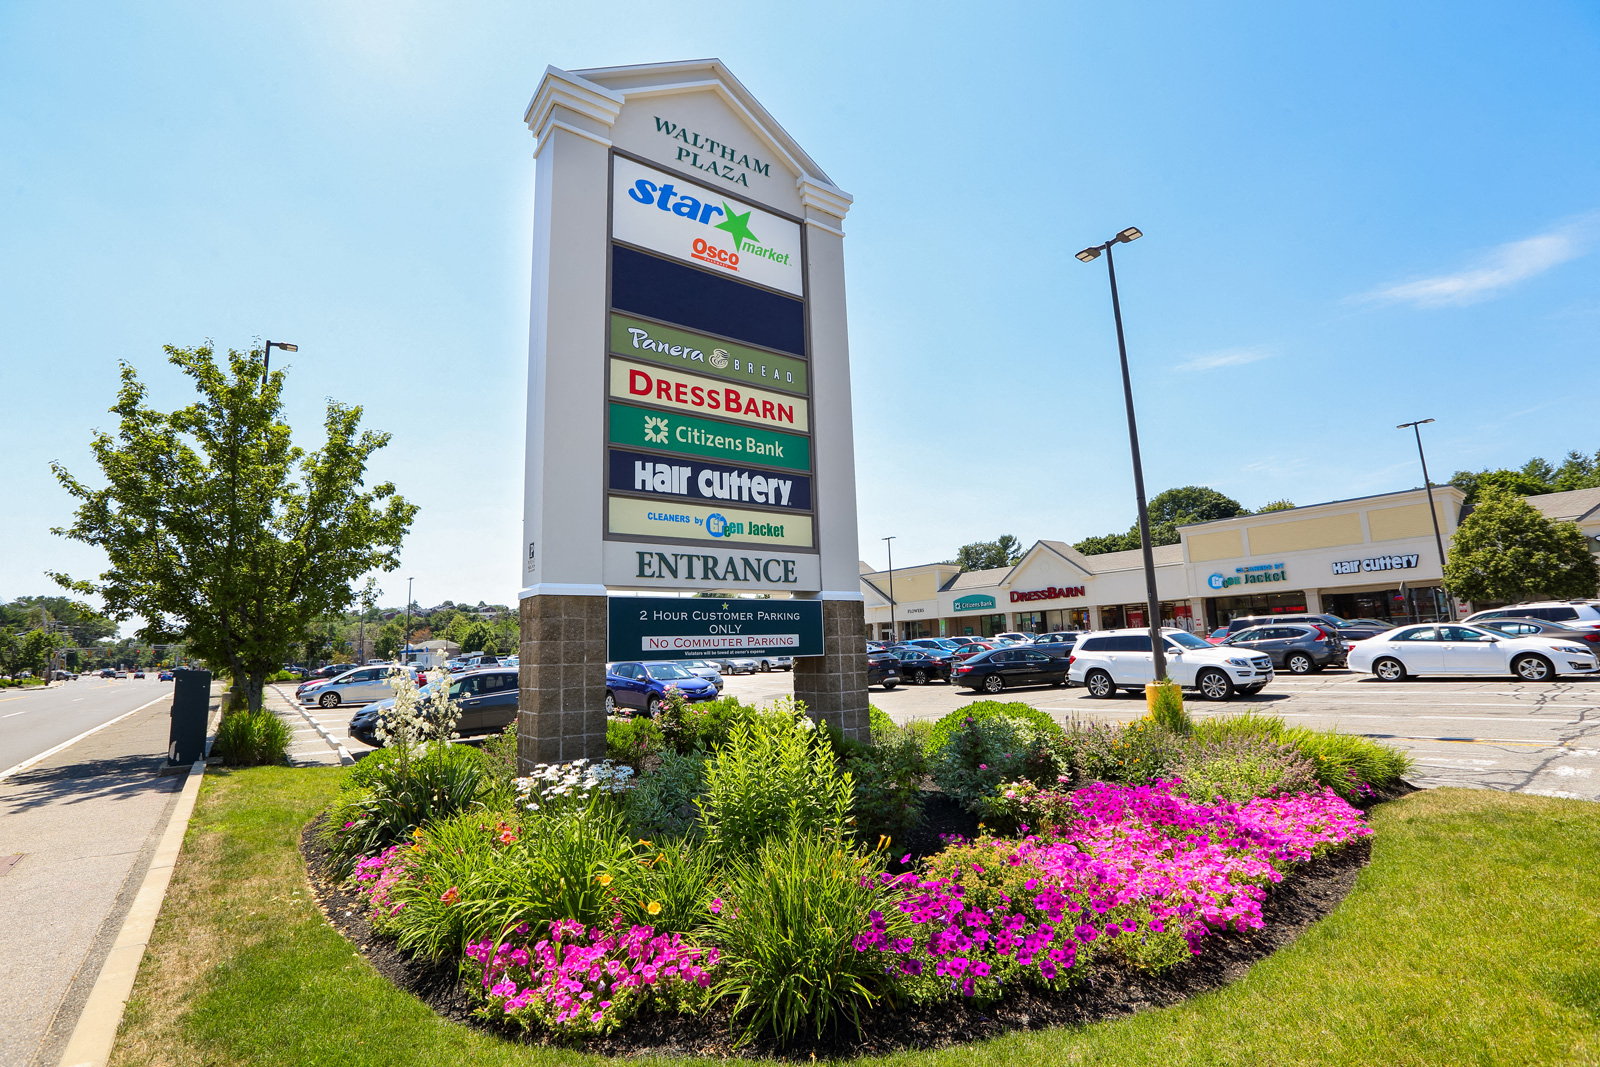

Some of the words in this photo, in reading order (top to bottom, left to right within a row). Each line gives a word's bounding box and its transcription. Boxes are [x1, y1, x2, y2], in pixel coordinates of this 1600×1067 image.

[653, 116, 771, 178] WALTHAM
[675, 146, 750, 187] PLAZA
[628, 178, 724, 225] star
[692, 238, 739, 265] Osco
[741, 241, 789, 266] market
[627, 327, 705, 363] Panera
[675, 426, 743, 451] Citizens
[746, 437, 784, 458] Bank
[634, 460, 692, 495] Hair
[698, 469, 792, 506] cuttery
[647, 512, 690, 524] CLEANERS
[694, 516, 704, 526] by
[706, 513, 744, 538] Green
[748, 521, 785, 538] Jacket
[635, 551, 798, 583] ENTRANCE
[1245, 571, 1286, 584] Jacket
[1332, 560, 1360, 575] Hair
[1362, 554, 1418, 572] cuttery
[639, 610, 648, 621] 2
[653, 610, 688, 621] HOUR
[692, 610, 753, 621] CUSTOMER
[757, 610, 800, 621] PARKING
[709, 624, 742, 634] ONLY
[673, 637, 742, 648] COMMUTER
[747, 636, 794, 646] PARKING
